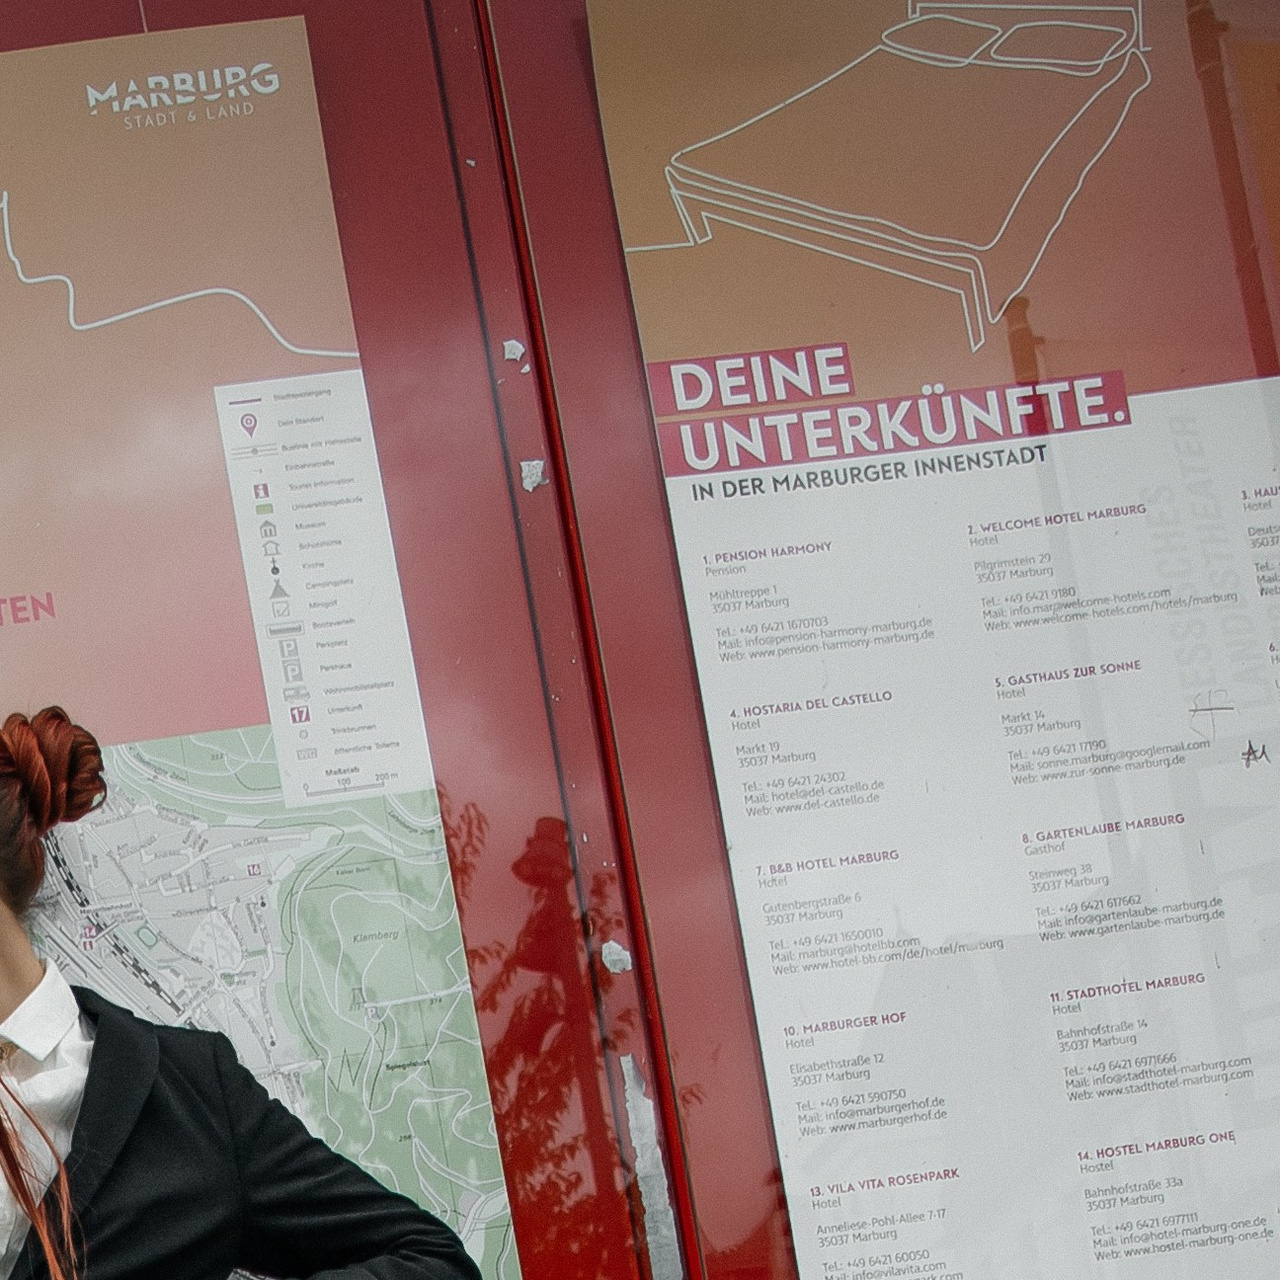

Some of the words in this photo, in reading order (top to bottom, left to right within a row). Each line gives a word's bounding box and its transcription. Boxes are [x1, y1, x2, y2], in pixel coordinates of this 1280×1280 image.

[86, 62, 280, 115] MARBURG
[123, 110, 178, 130] STADT
[187, 111, 197, 123] &
[206, 102, 254, 121] LAND
[670, 346, 851, 411] DEINE
[679, 377, 1126, 472] UNTERKÜNFTE.
[691, 481, 714, 501] IN
[721, 476, 766, 498] DER
[771, 460, 908, 493] MARBURGER
[913, 442, 1047, 477] INNENSTADT
[1254, 485, 1280, 499] HAU
[966, 523, 977, 535] 2.
[978, 515, 1042, 533] WELCOME
[1043, 510, 1085, 526] HOTEL
[1086, 502, 1147, 521] MARBURG
[968, 533, 999, 547] Hotel
[702, 554, 712, 565] 1.
[714, 547, 767, 564] PENSION
[769, 540, 832, 558] HARMONY
[704, 564, 747, 577] Pension
[994, 676, 1005, 688] 5.
[1006, 667, 1070, 686] GASTHAUS
[1072, 664, 1097, 678] ZUR
[1098, 658, 1142, 675] SONNE
[729, 708, 740, 718] 4.
[742, 701, 803, 717] HOSTARIA
[804, 697, 829, 710] DEL
[830, 689, 893, 707] CASTELLO
[995, 685, 1026, 700] Hotel
[292, 706, 310, 722] 17
[730, 717, 761, 731] Hotel
[1021, 832, 1033, 844] 8.
[1035, 820, 1122, 842] GARTENLAUBE
[1124, 812, 1185, 830] MARBURG
[1023, 839, 1065, 856] Gasthof
[755, 864, 766, 876] 7.
[768, 861, 793, 875] B&B
[795, 856, 837, 871] HOTEL
[838, 848, 899, 866] MARBURG
[757, 874, 788, 889] Hotel
[352, 927, 400, 945] Klamberg
[1049, 989, 1064, 1002] 11.
[1065, 980, 1143, 1001] STADTHOTEL
[1144, 971, 1206, 990] MARBURG
[1051, 1000, 1082, 1015] Hotel
[782, 1024, 799, 1037] 10.
[801, 1014, 879, 1034] MARBURGER
[880, 1010, 906, 1025] HOF
[784, 1035, 815, 1050] Hotel
[788, 1053, 871, 1075] Elisabethstraße
[872, 1052, 885, 1064] 12
[791, 1072, 822, 1087] 35037
[824, 1068, 871, 1082] Marburg
[794, 1099, 816, 1111] Tel.:
[819, 1096, 839, 1107] +49
[840, 1092, 865, 1107] 6421
[866, 1087, 907, 1103] 590750
[1076, 1150, 1093, 1162] 14.
[1095, 1142, 1143, 1159] HOSTEL
[1144, 1133, 1206, 1153] MARBURG
[1207, 1129, 1236, 1144] ONE
[1078, 1158, 1114, 1174] Hostel
[809, 1185, 825, 1197] 13.
[826, 1181, 856, 1194] VILA
[857, 1177, 885, 1190] VITA
[886, 1166, 960, 1187] ROSENPARK
[810, 1195, 842, 1210] Hotel
